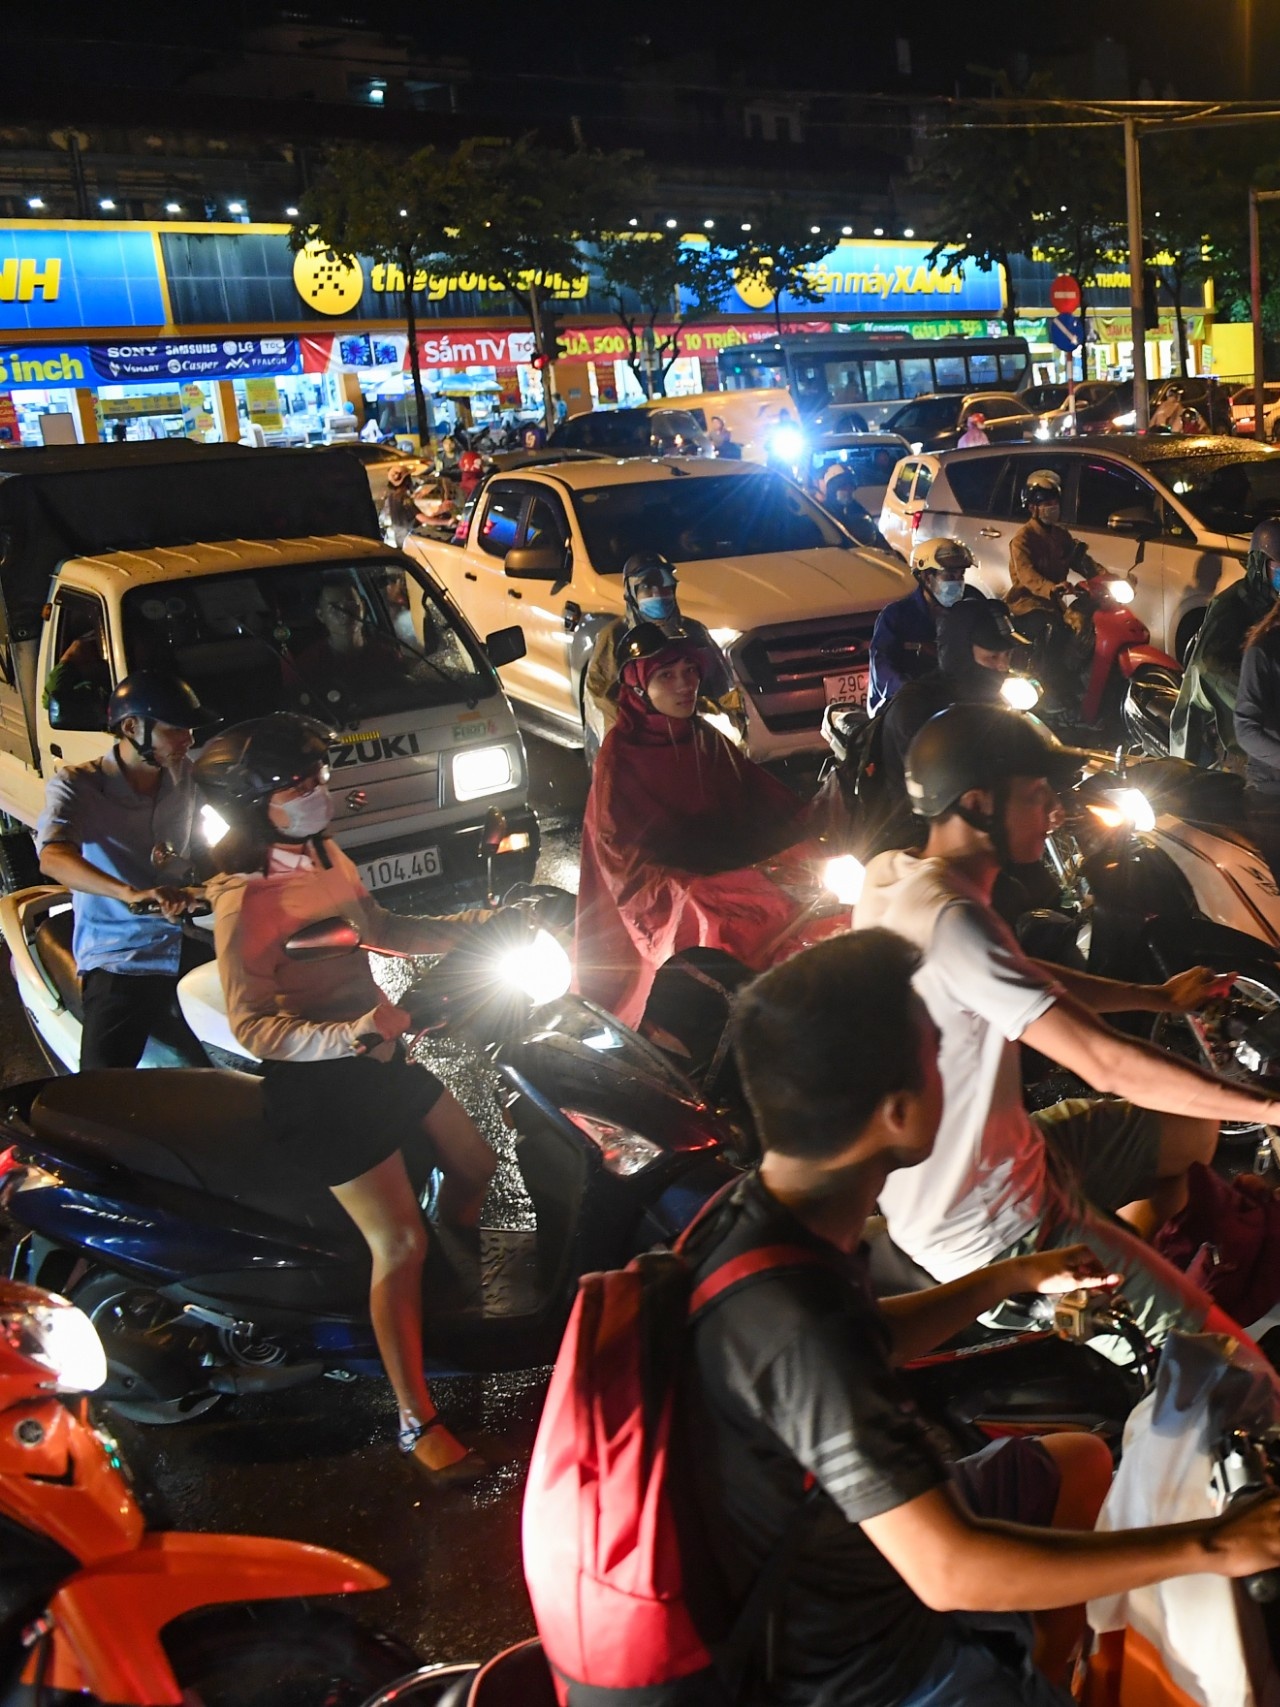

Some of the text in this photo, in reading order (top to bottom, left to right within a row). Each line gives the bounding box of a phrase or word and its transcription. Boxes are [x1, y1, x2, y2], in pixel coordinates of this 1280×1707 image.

[844, 265, 894, 299] máy
[892, 265, 963, 294] XANH
[107, 346, 157, 358] SONY
[165, 343, 218, 356] SAMSUNG
[238, 341, 254, 353] LG
[424, 335, 477, 363] Sắm
[476, 339, 506, 361] TV
[594, 335, 624, 353] 500
[685, 334, 701, 349] 10
[10, 353, 84, 382] inch
[182, 360, 219, 373] Casper
[838, 674, 866, 694] 29C
[330, 733, 420, 769] ZUKI
